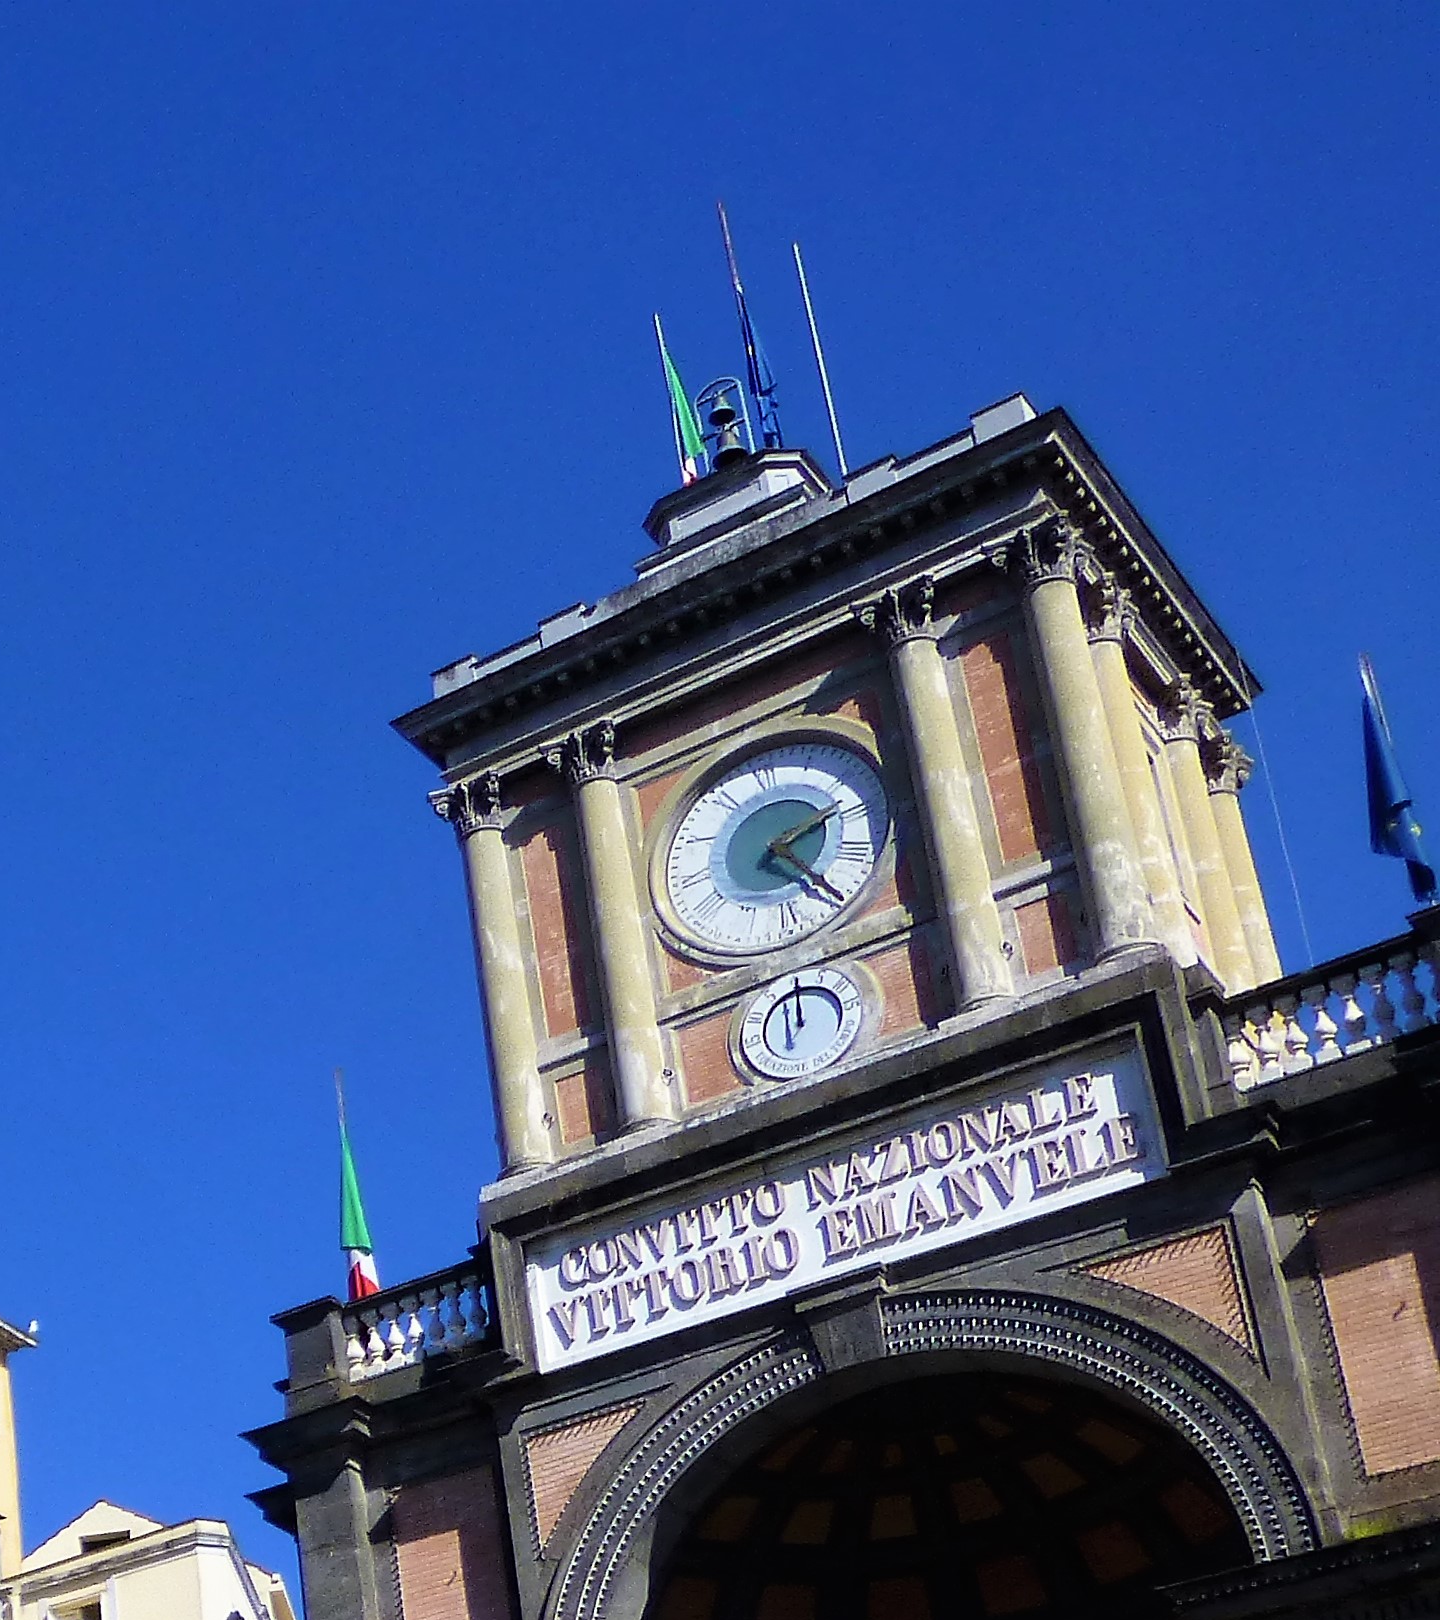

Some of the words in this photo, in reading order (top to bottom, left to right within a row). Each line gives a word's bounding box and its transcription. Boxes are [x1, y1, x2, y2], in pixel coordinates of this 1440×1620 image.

[546, 1227, 801, 1349] VITTORIO
[816, 1112, 1138, 1266] EMANVELE
[558, 1180, 787, 1290] CONVITTO
[806, 1072, 1098, 1211] NAZIONALE
